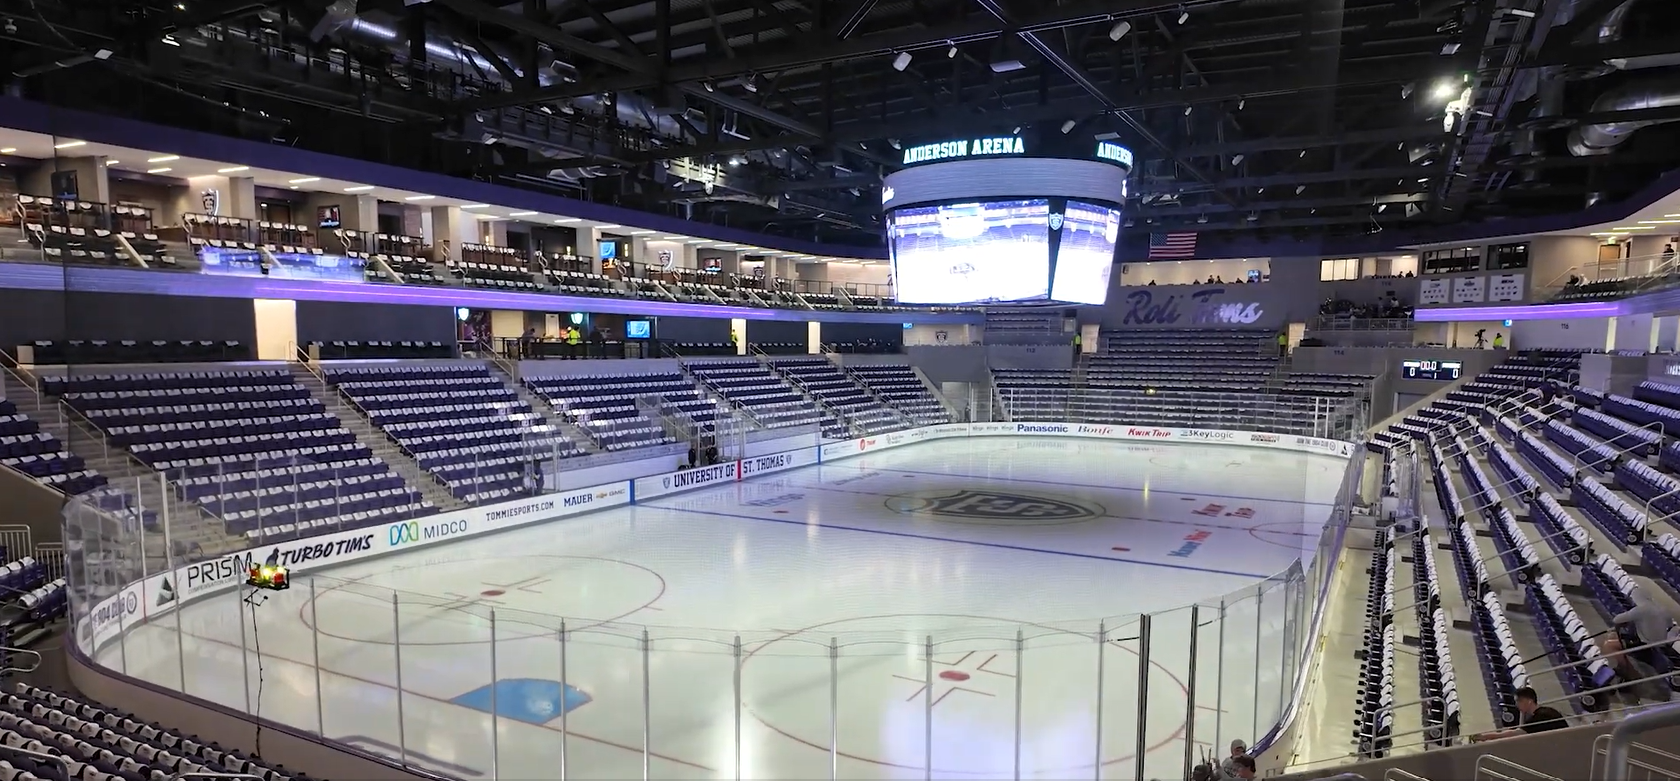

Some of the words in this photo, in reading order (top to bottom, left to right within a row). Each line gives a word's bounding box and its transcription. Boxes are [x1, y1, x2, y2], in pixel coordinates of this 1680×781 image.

[903, 140, 968, 164] ANDERSON
[971, 137, 1024, 156] ARENA
[1410, 367, 1415, 377] 0
[1452, 369, 1459, 379] 0
[1017, 424, 1068, 433] Panasonic
[674, 466, 724, 488] UNIVERSITY
[726, 464, 735, 477] OF
[743, 461, 754, 474] ST.
[757, 455, 784, 471] THOMAS
[564, 493, 593, 507] MAUER
[486, 501, 554, 521] TOMMIESPORTS.COM
[424, 519, 467, 540] MIDCO
[280, 541, 334, 566] TURBO
[335, 534, 374, 554] TIM'S
[187, 551, 252, 588] PRISM
